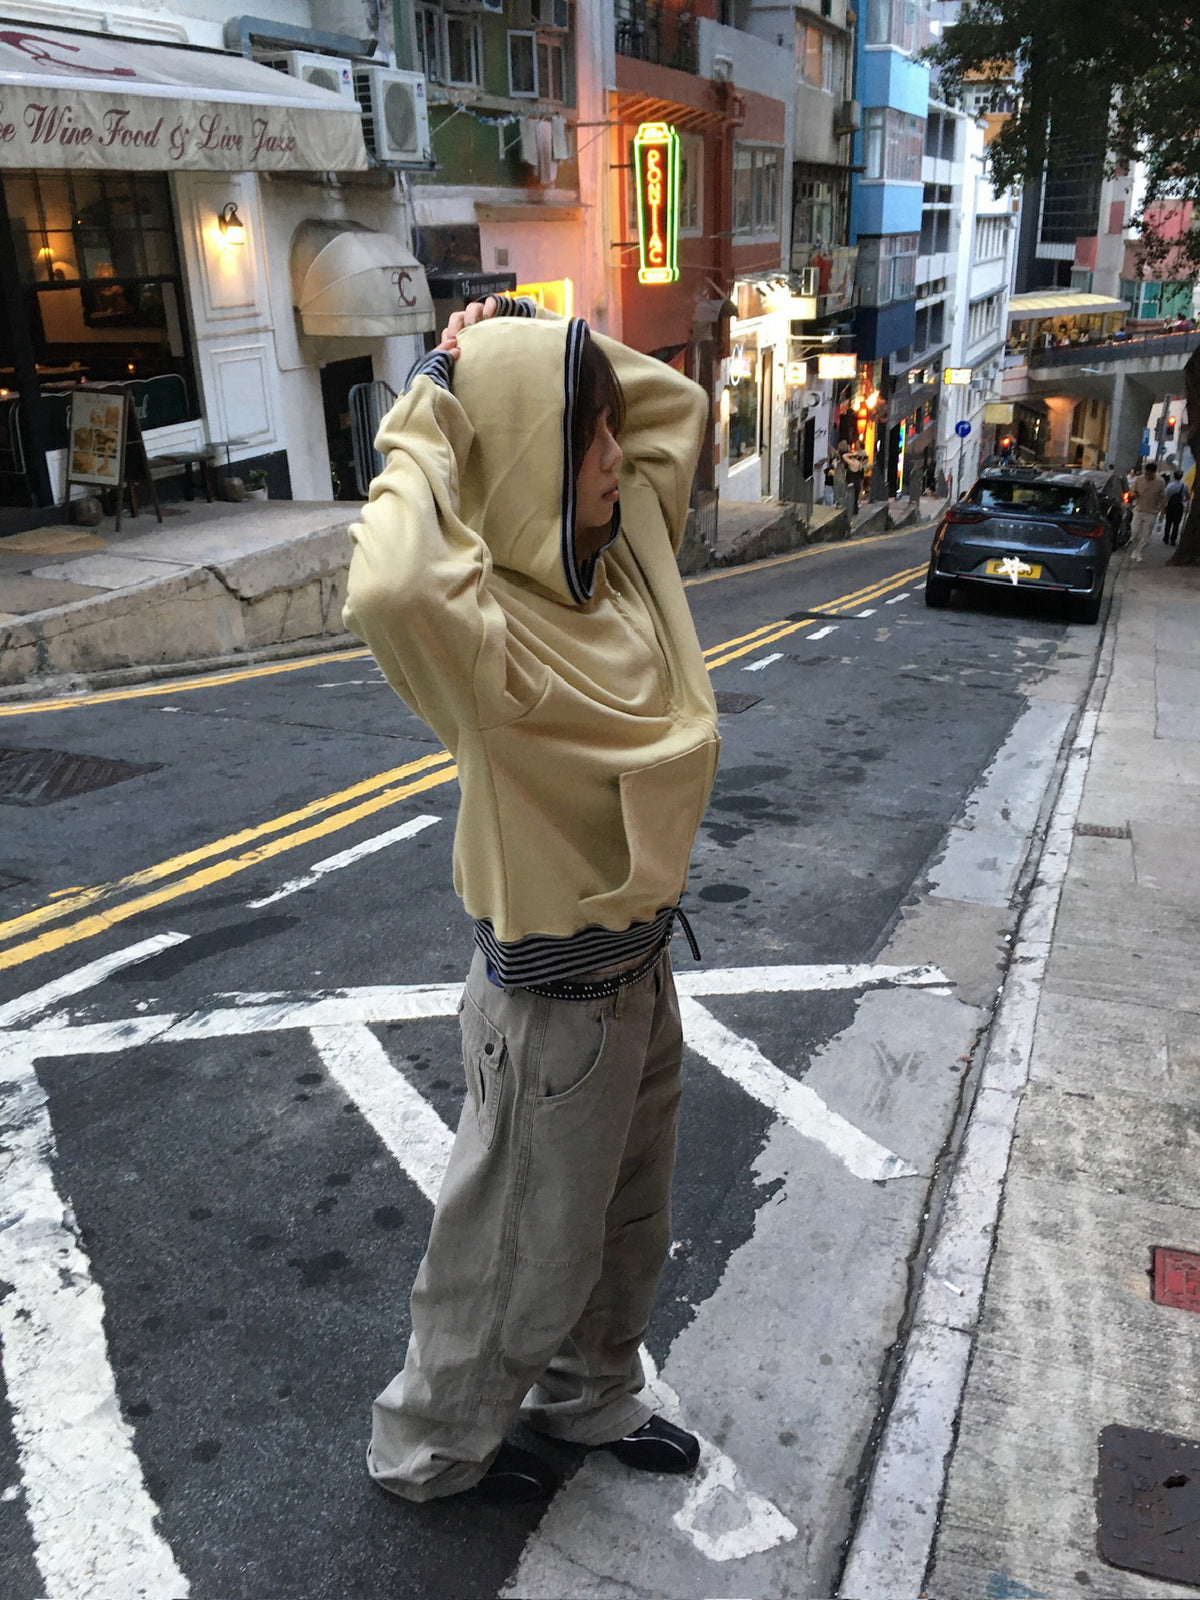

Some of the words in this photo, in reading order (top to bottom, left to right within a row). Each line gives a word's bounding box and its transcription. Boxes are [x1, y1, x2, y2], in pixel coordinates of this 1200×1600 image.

[24, 103, 93, 145] Wine
[98, 108, 164, 147] Food
[168, 115, 189, 160] &
[195, 114, 243, 151] Live
[250, 117, 297, 162] Jazz
[646, 149, 663, 264] PONTIAC
